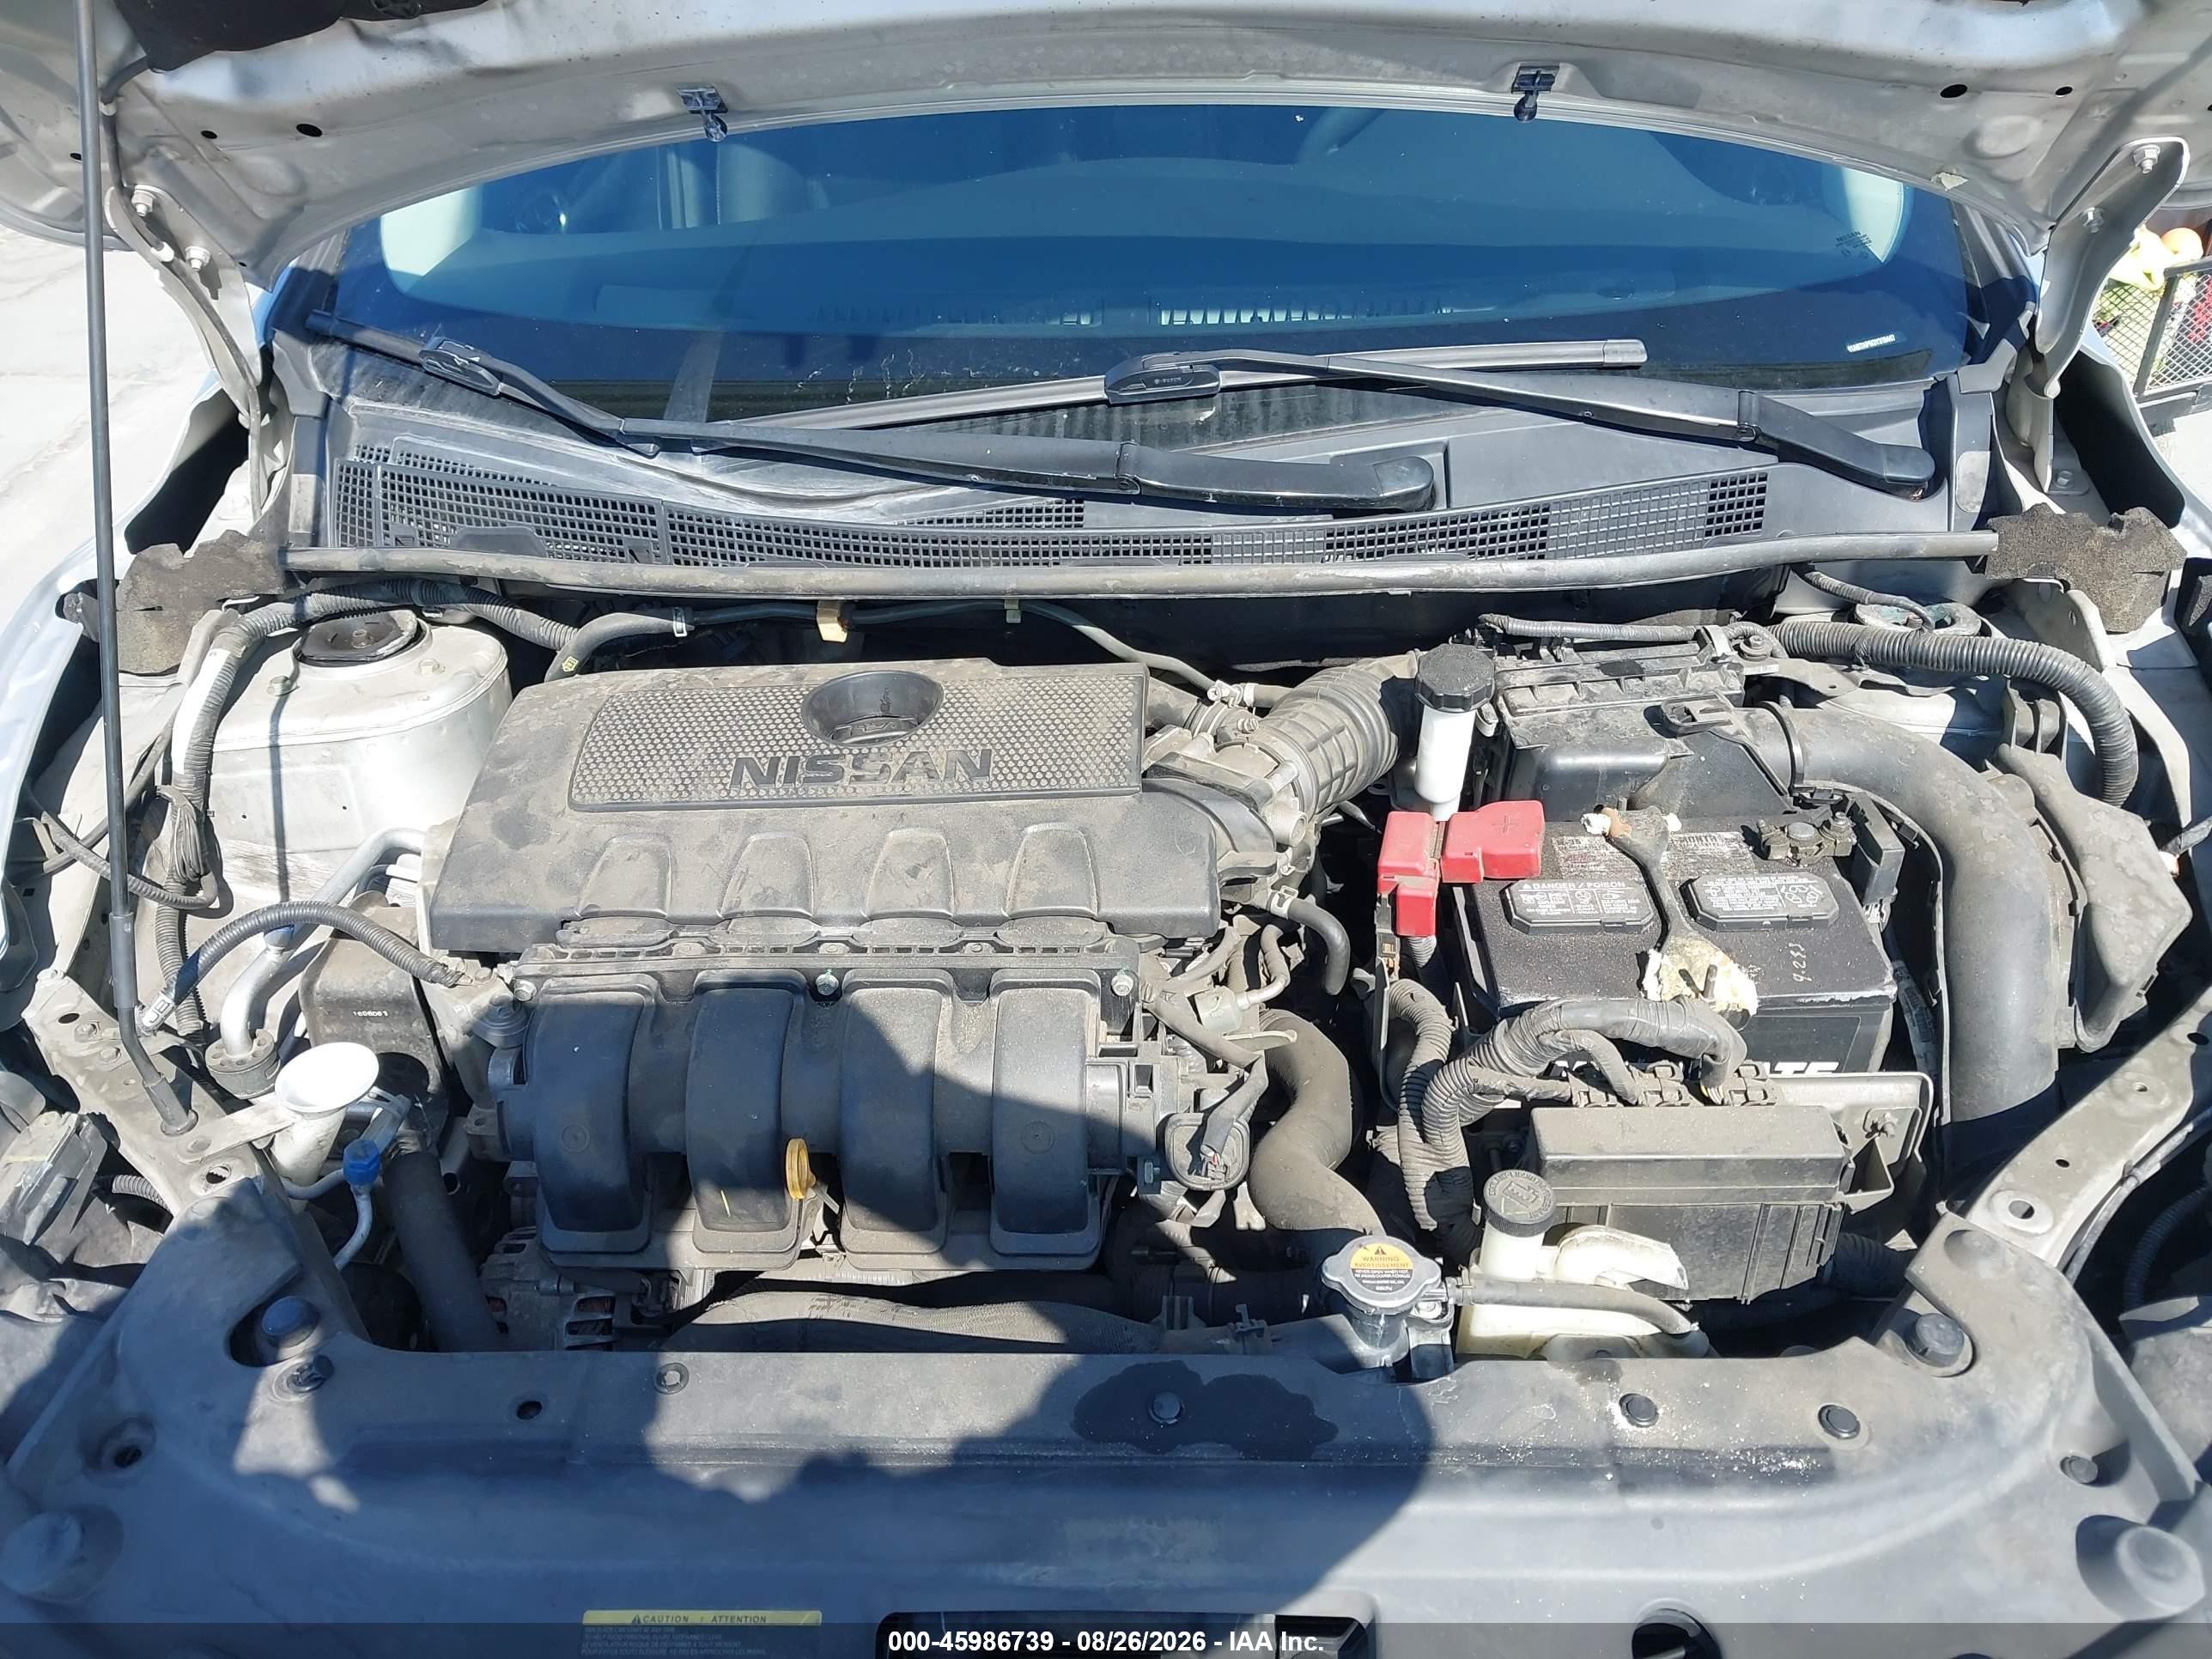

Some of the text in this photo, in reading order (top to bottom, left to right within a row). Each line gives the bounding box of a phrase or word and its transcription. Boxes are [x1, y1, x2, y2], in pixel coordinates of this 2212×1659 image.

[730, 749, 992, 787] NISSAN
[643, 1614, 690, 1623] CAUTION
[710, 1614, 767, 1623] ATTENTION
